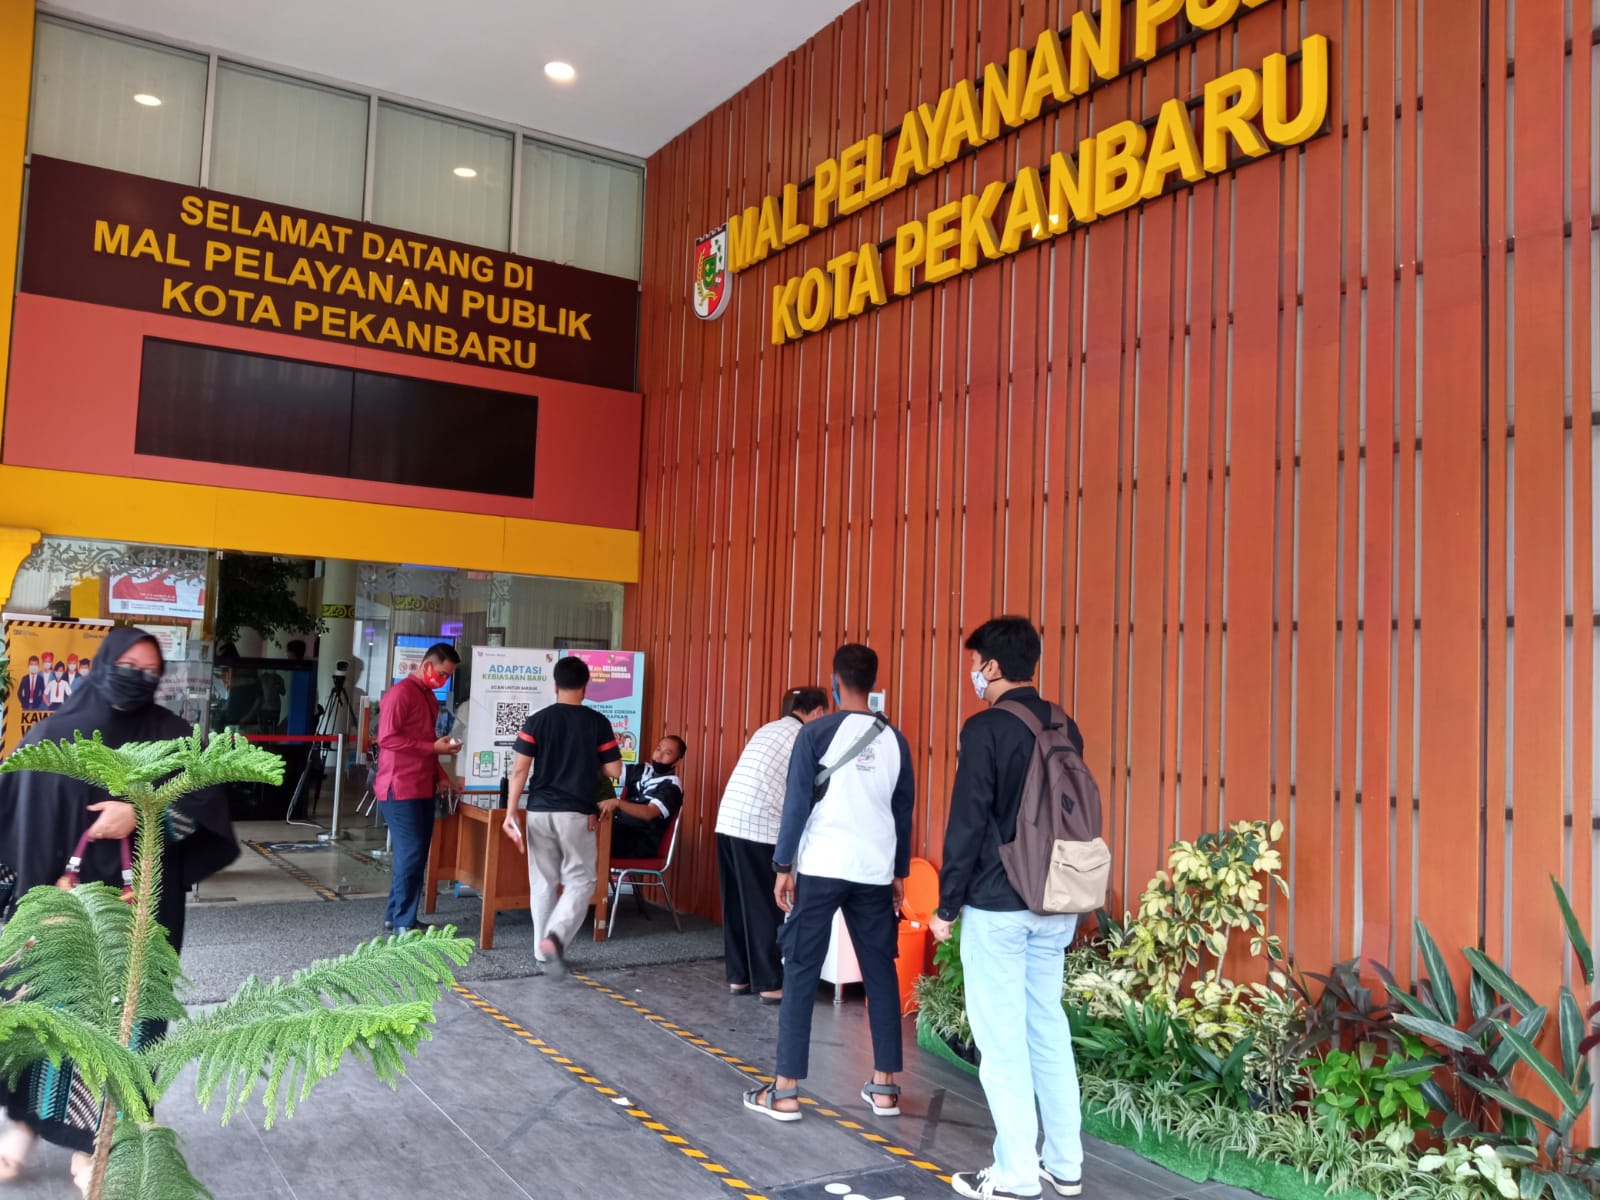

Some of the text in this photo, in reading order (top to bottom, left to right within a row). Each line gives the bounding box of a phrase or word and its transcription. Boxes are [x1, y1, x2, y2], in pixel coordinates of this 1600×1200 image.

[727, 0, 1122, 273] MAL PELAYANAN
[771, 34, 1329, 346] KOTA PEKANBARU
[93, 219, 592, 340] MAL PELAYANAN PUBLIK
[180, 195, 534, 291] SELAMAT DATANG DI
[162, 278, 538, 369] KOTA PEKANBARU
[482, 673, 526, 681] KEBIASAAN
[489, 664, 542, 674] ADAPTASI
